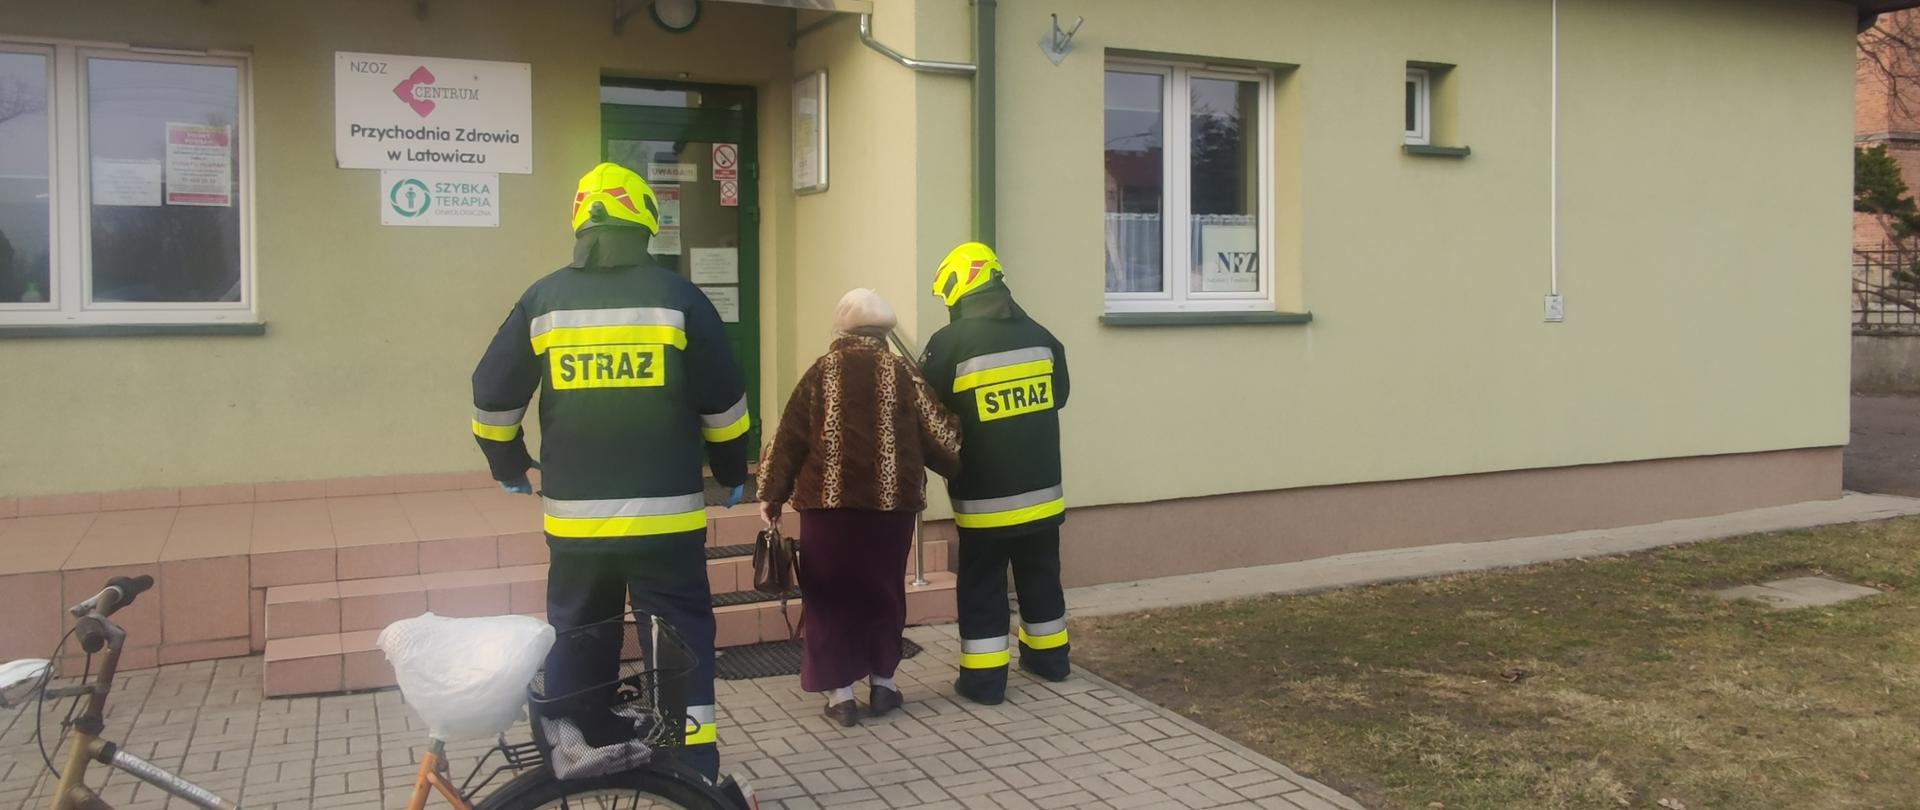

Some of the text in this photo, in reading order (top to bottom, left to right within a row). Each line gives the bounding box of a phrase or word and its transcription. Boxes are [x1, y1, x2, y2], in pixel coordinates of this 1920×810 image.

[350, 61, 388, 75] NZOZ
[414, 86, 480, 101] CENTRUM
[350, 124, 520, 144] Przychodnia Zdrowia
[387, 148, 486, 164] w Latowiczu
[434, 182, 491, 194] SZYBKA
[434, 196, 491, 208] TERAPIA
[1217, 251, 1257, 273] NFZ
